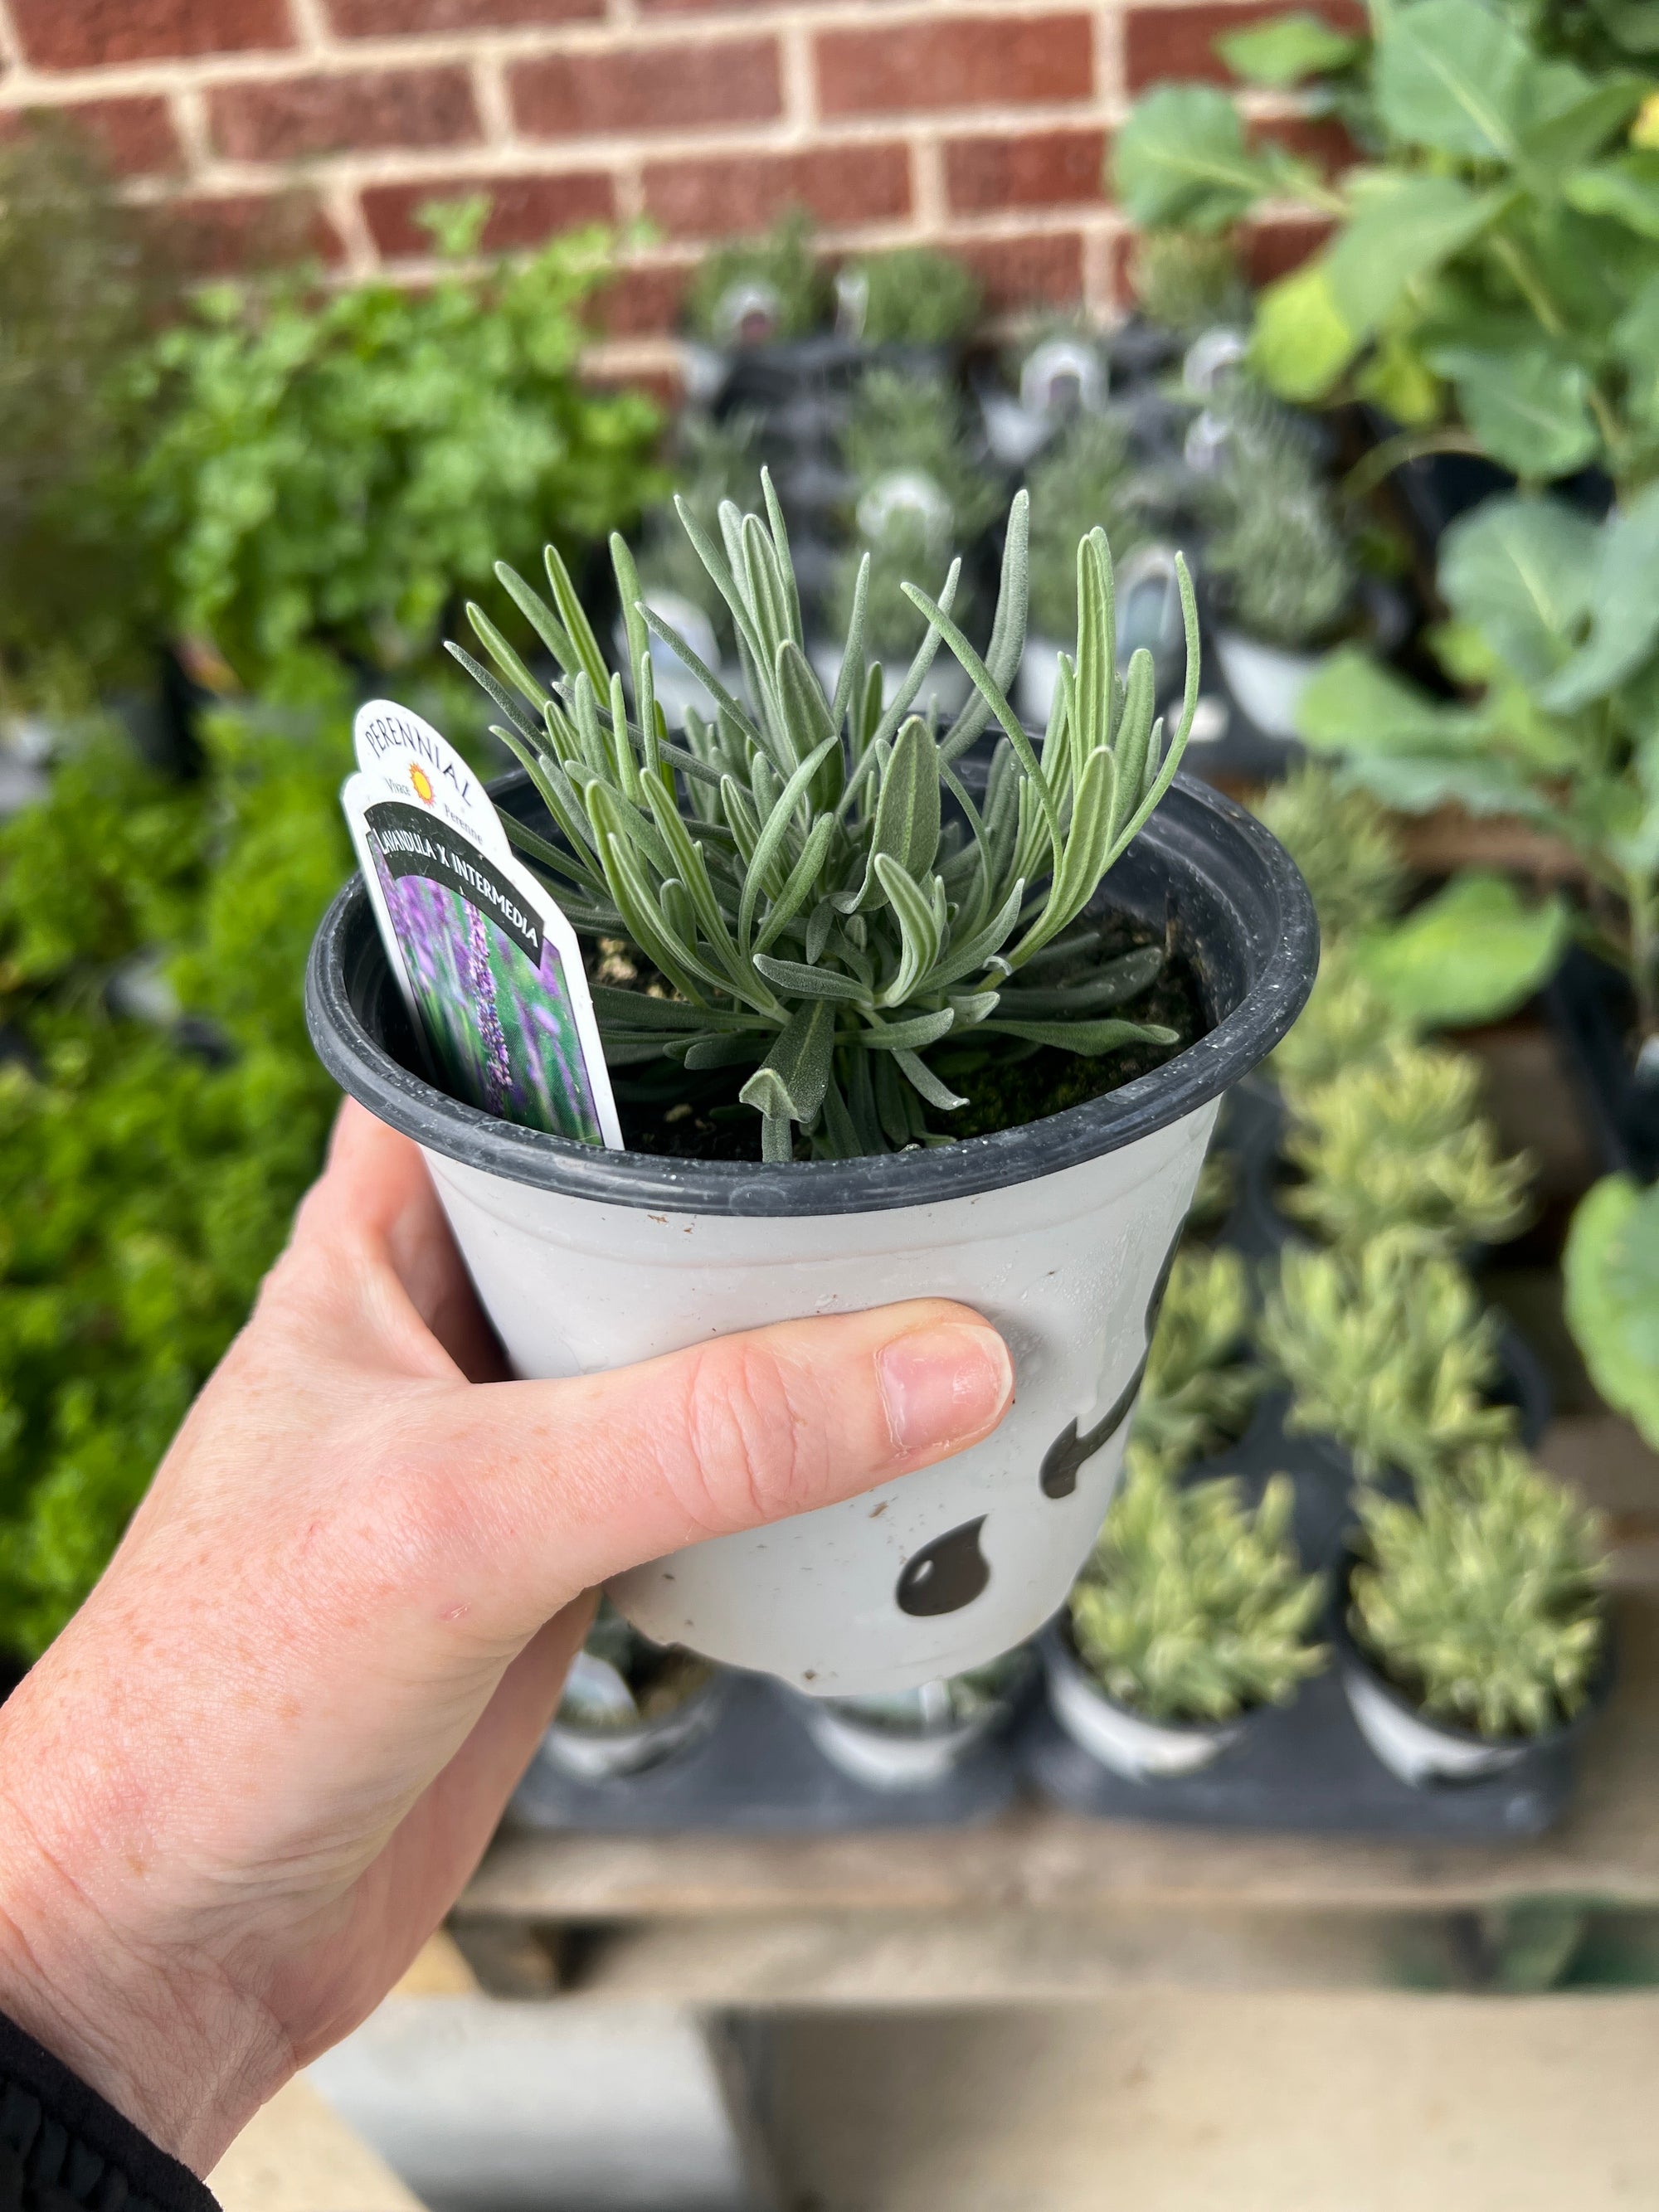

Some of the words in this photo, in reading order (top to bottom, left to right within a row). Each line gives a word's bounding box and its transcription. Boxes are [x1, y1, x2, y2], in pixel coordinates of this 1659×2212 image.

[365, 717, 472, 807] PERENNIAL
[384, 777, 411, 797] Vivace
[444, 804, 484, 845] Perenne
[372, 828, 437, 861] LAVANDULA
[451, 853, 539, 949] INTERMEDIA
